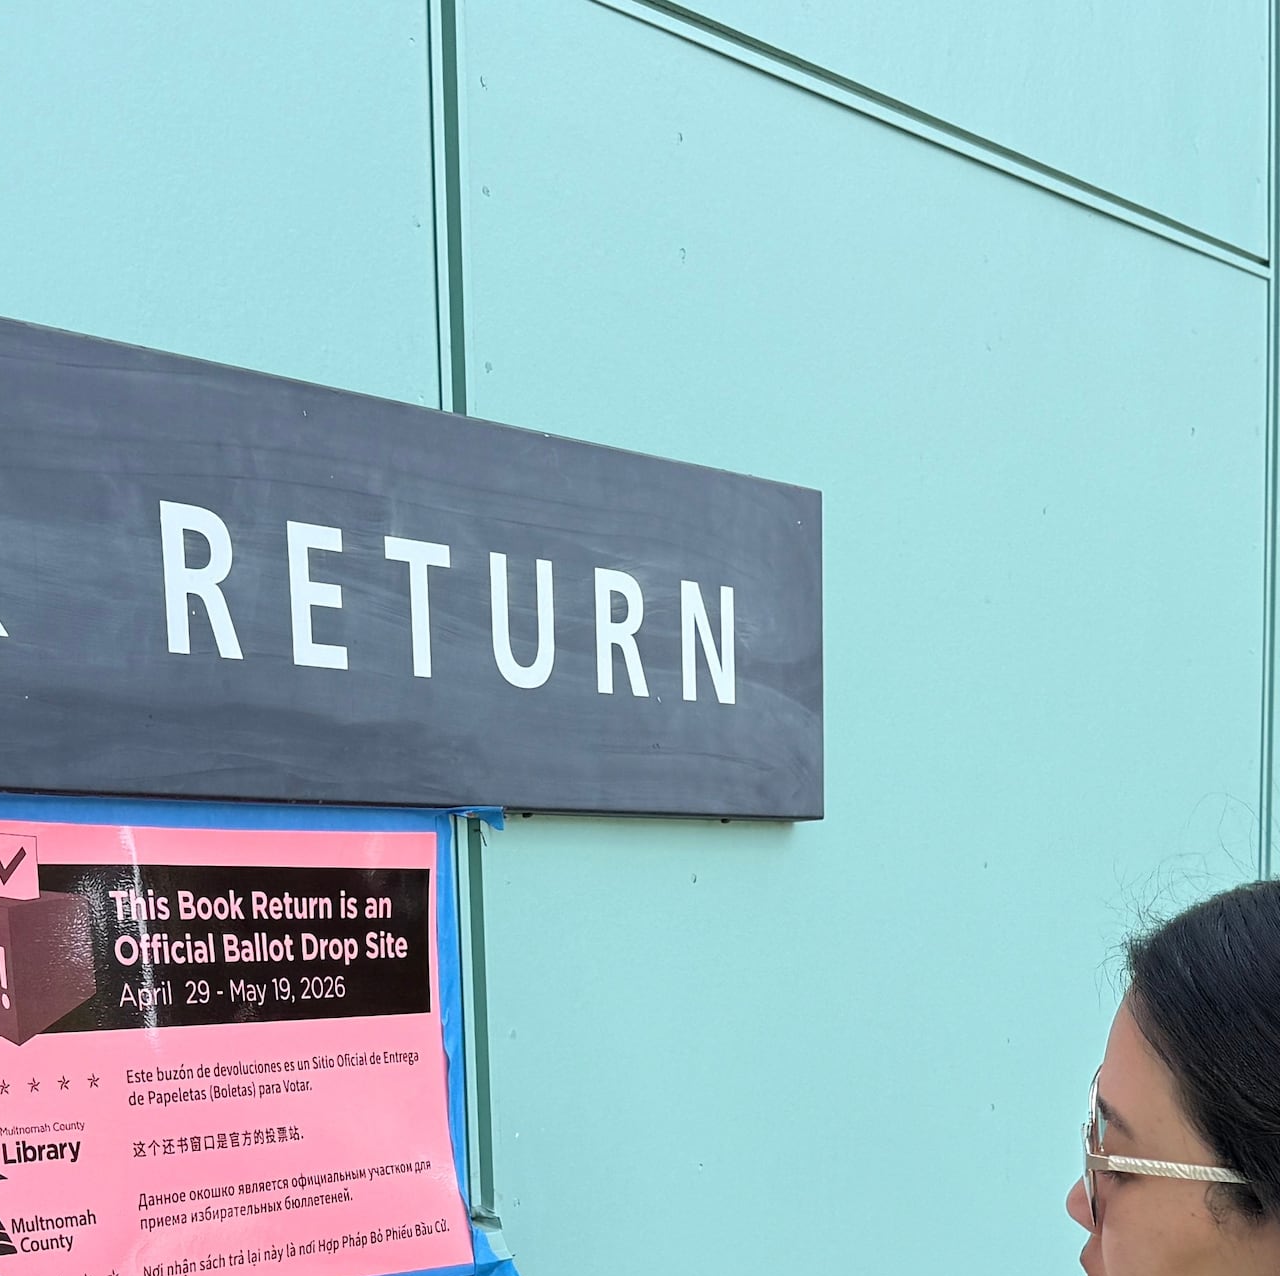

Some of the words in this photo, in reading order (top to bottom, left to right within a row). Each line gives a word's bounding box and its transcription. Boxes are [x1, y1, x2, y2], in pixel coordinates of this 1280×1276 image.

[159, 500, 736, 704] RETURN
[109, 889, 170, 921] This
[177, 890, 245, 920] Book
[252, 891, 332, 919] Return
[340, 890, 358, 919] is
[364, 896, 392, 918] an
[114, 933, 216, 966] Official
[222, 932, 294, 963] Ballot
[301, 933, 358, 966] Drop
[366, 930, 408, 959] Site
[120, 980, 172, 1010] April
[185, 980, 210, 1004] 29
[230, 979, 266, 1006] May
[272, 978, 296, 1002] 19,
[300, 976, 346, 999] 2026
[126, 1070, 153, 1083] Este
[157, 1064, 193, 1081] buzón
[197, 1064, 210, 1078] de
[213, 1060, 282, 1077] devoluciones
[284, 1060, 294, 1071] es
[298, 1060, 310, 1070] un
[312, 1055, 335, 1069] Sitio
[337, 1052, 368, 1067] Oficial
[370, 1052, 381, 1064] de
[383, 1051, 419, 1065] Entrega
[128, 1091, 144, 1106] de
[148, 1088, 207, 1107] Papeletas
[210, 1082, 256, 1101] (Boletas)
[259, 1083, 281, 1098] para
[283, 1079, 312, 1093] Votar.
[0, 1124, 50, 1136] Multnomah
[53, 1121, 85, 1132] County
[2, 1141, 80, 1165] Library
[138, 1192, 186, 1211] Данное
[190, 1186, 235, 1200] окошко
[238, 1179, 289, 1195] является
[292, 1167, 366, 1190] официальным
[368, 1162, 412, 1180] участком
[415, 1160, 431, 1173] для
[11, 1209, 96, 1234] Multnomah
[141, 1213, 187, 1232] приема
[191, 1200, 282, 1222] избирательных
[285, 1188, 352, 1210] бюллетеней.
[20, 1234, 74, 1252] County
[167, 1259, 196, 1276] nhận
[200, 1254, 225, 1271] sách
[229, 1250, 244, 1266] trả
[248, 1248, 260, 1267] lại
[264, 1245, 283, 1263] này
[286, 1242, 296, 1257] là
[299, 1240, 315, 1255] nơi
[319, 1239, 339, 1254] Hợp
[342, 1232, 368, 1248] Pháp
[386, 1225, 412, 1241] Phiếu
